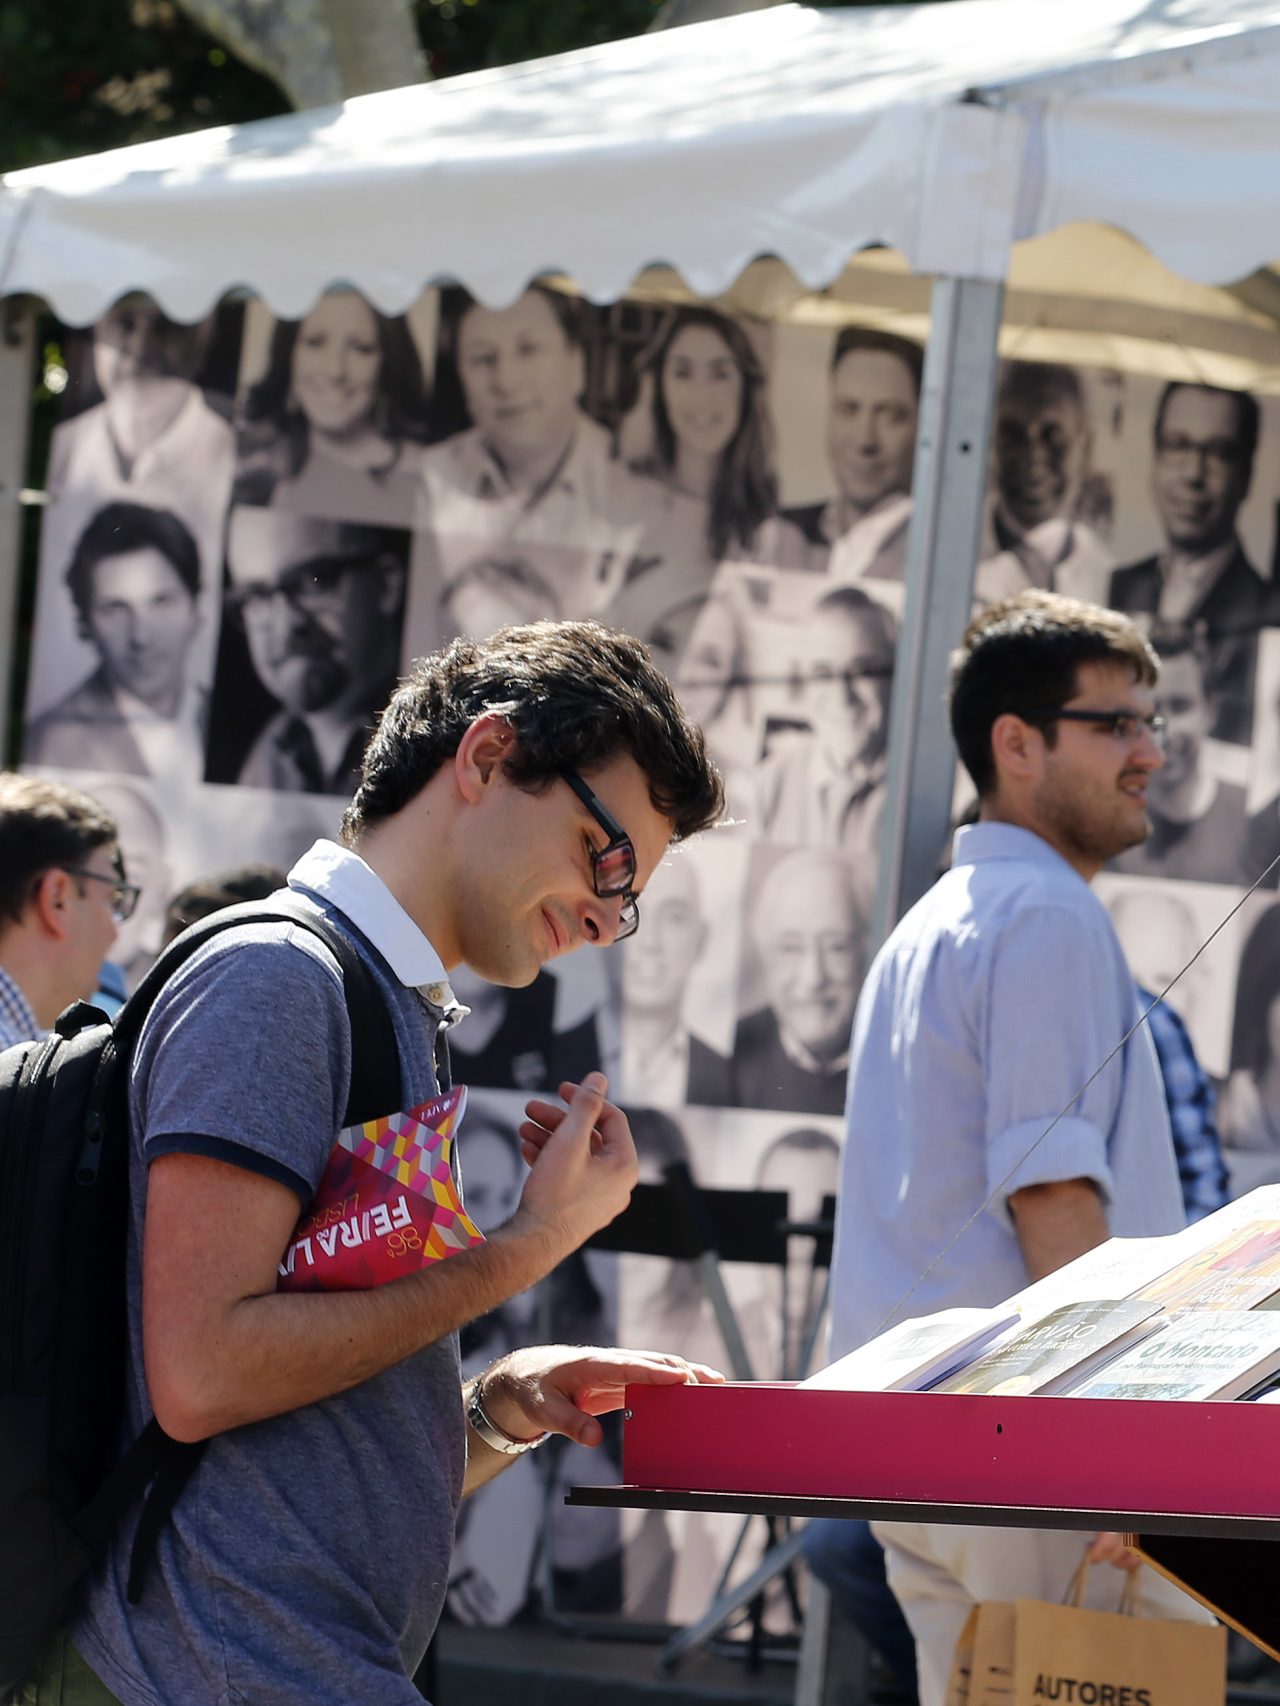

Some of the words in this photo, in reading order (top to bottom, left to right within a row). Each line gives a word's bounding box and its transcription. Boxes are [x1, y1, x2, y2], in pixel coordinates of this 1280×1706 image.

[1139, 1342, 1164, 1358] O
[1160, 1342, 1259, 1358] Montado
[1033, 1673, 1151, 1706] AUTORES
